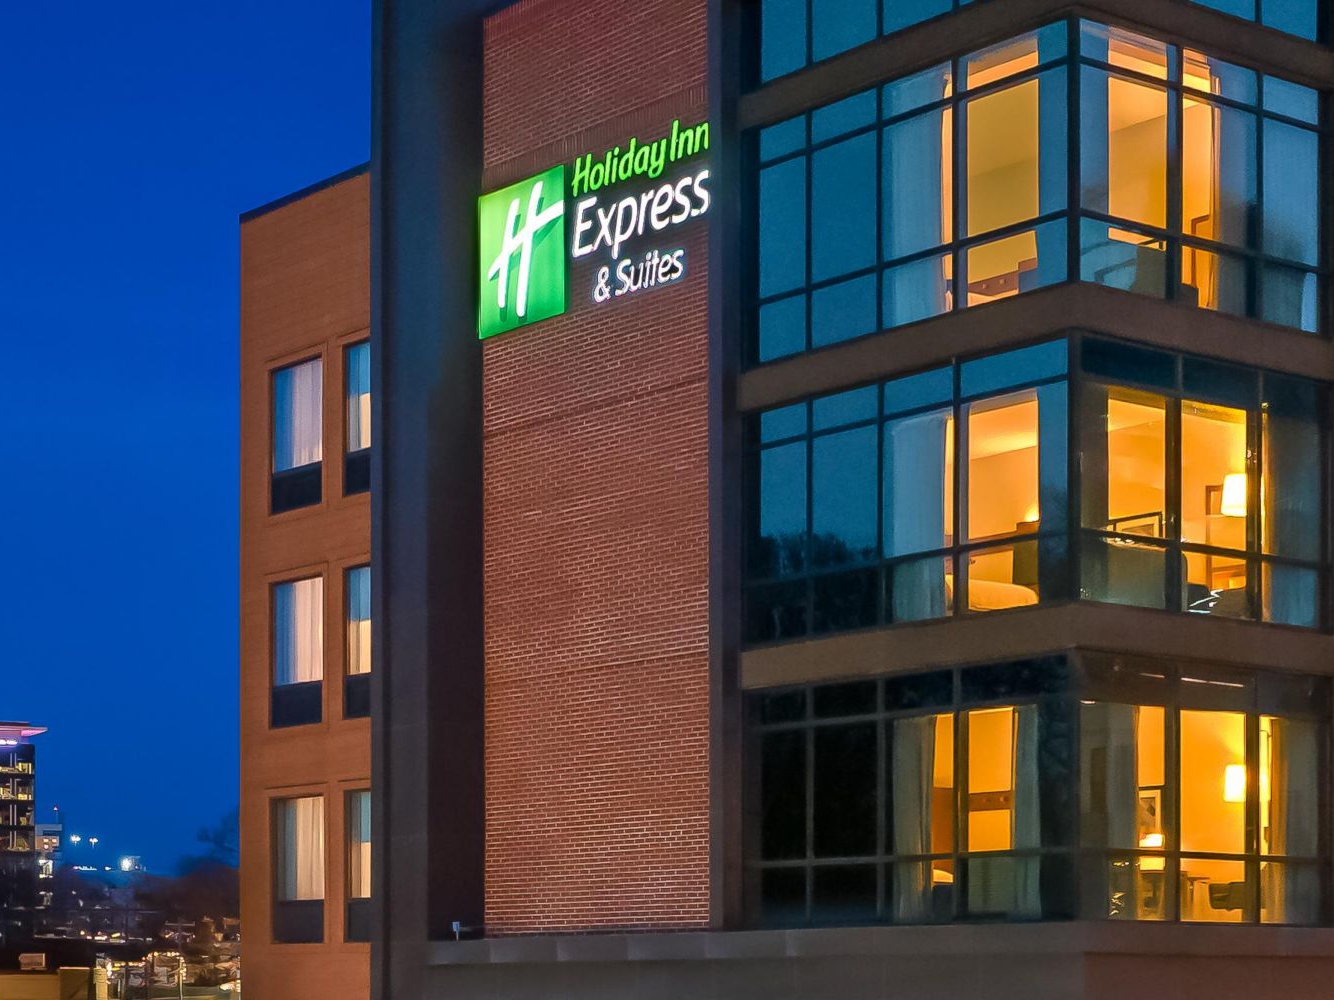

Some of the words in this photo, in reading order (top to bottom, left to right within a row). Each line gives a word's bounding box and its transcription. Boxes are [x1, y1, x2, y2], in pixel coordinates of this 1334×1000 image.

[571, 137, 667, 197] Holiday
[671, 119, 709, 162] Inn
[572, 169, 709, 259] Express
[593, 265, 612, 303] &
[615, 249, 685, 296] Suites
